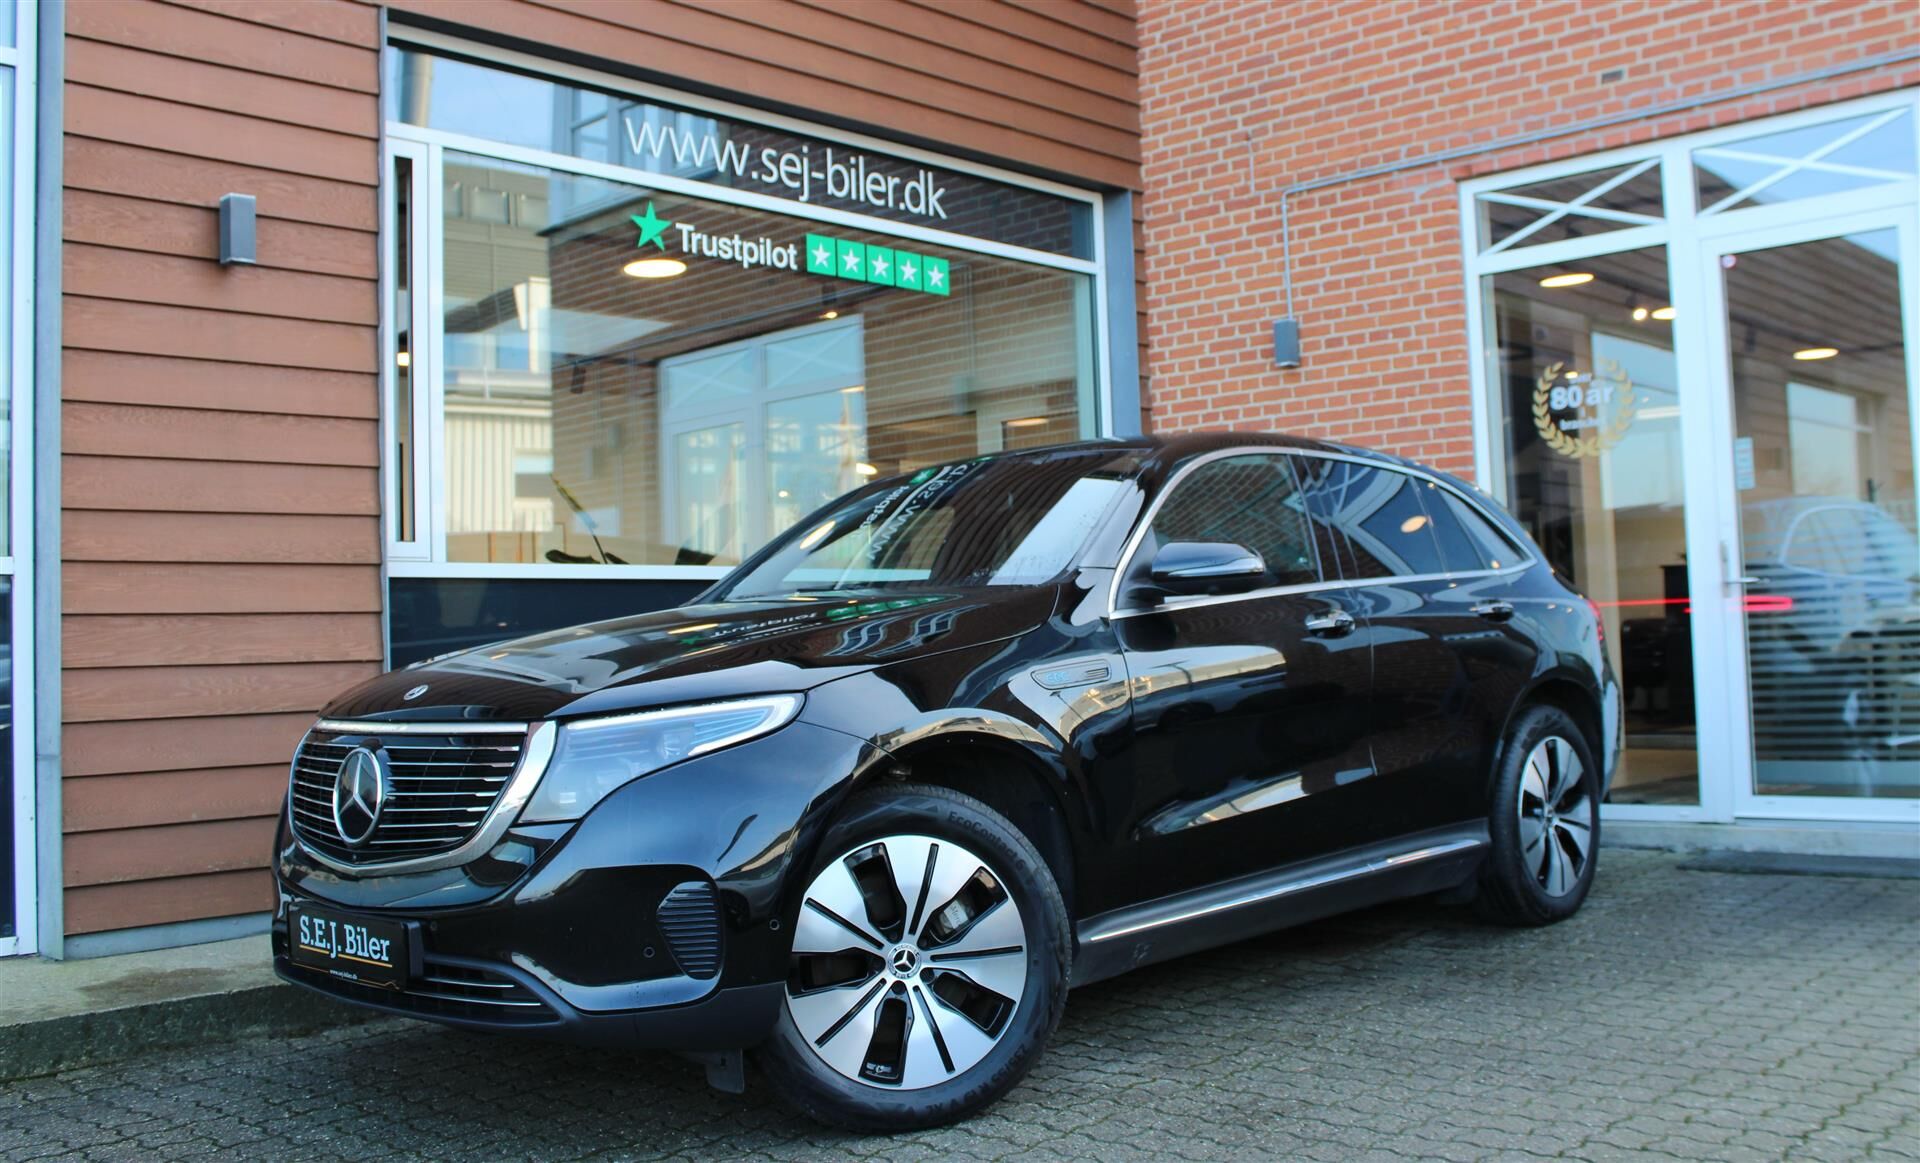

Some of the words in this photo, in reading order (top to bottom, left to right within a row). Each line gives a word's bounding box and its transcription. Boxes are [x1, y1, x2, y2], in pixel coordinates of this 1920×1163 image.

[625, 117, 947, 219] www.sej-biler.dk
[676, 223, 797, 270] Trustpilot
[1550, 385, 1583, 410] 80
[300, 915, 341, 958] S.E.J.
[344, 923, 390, 961] Biler
